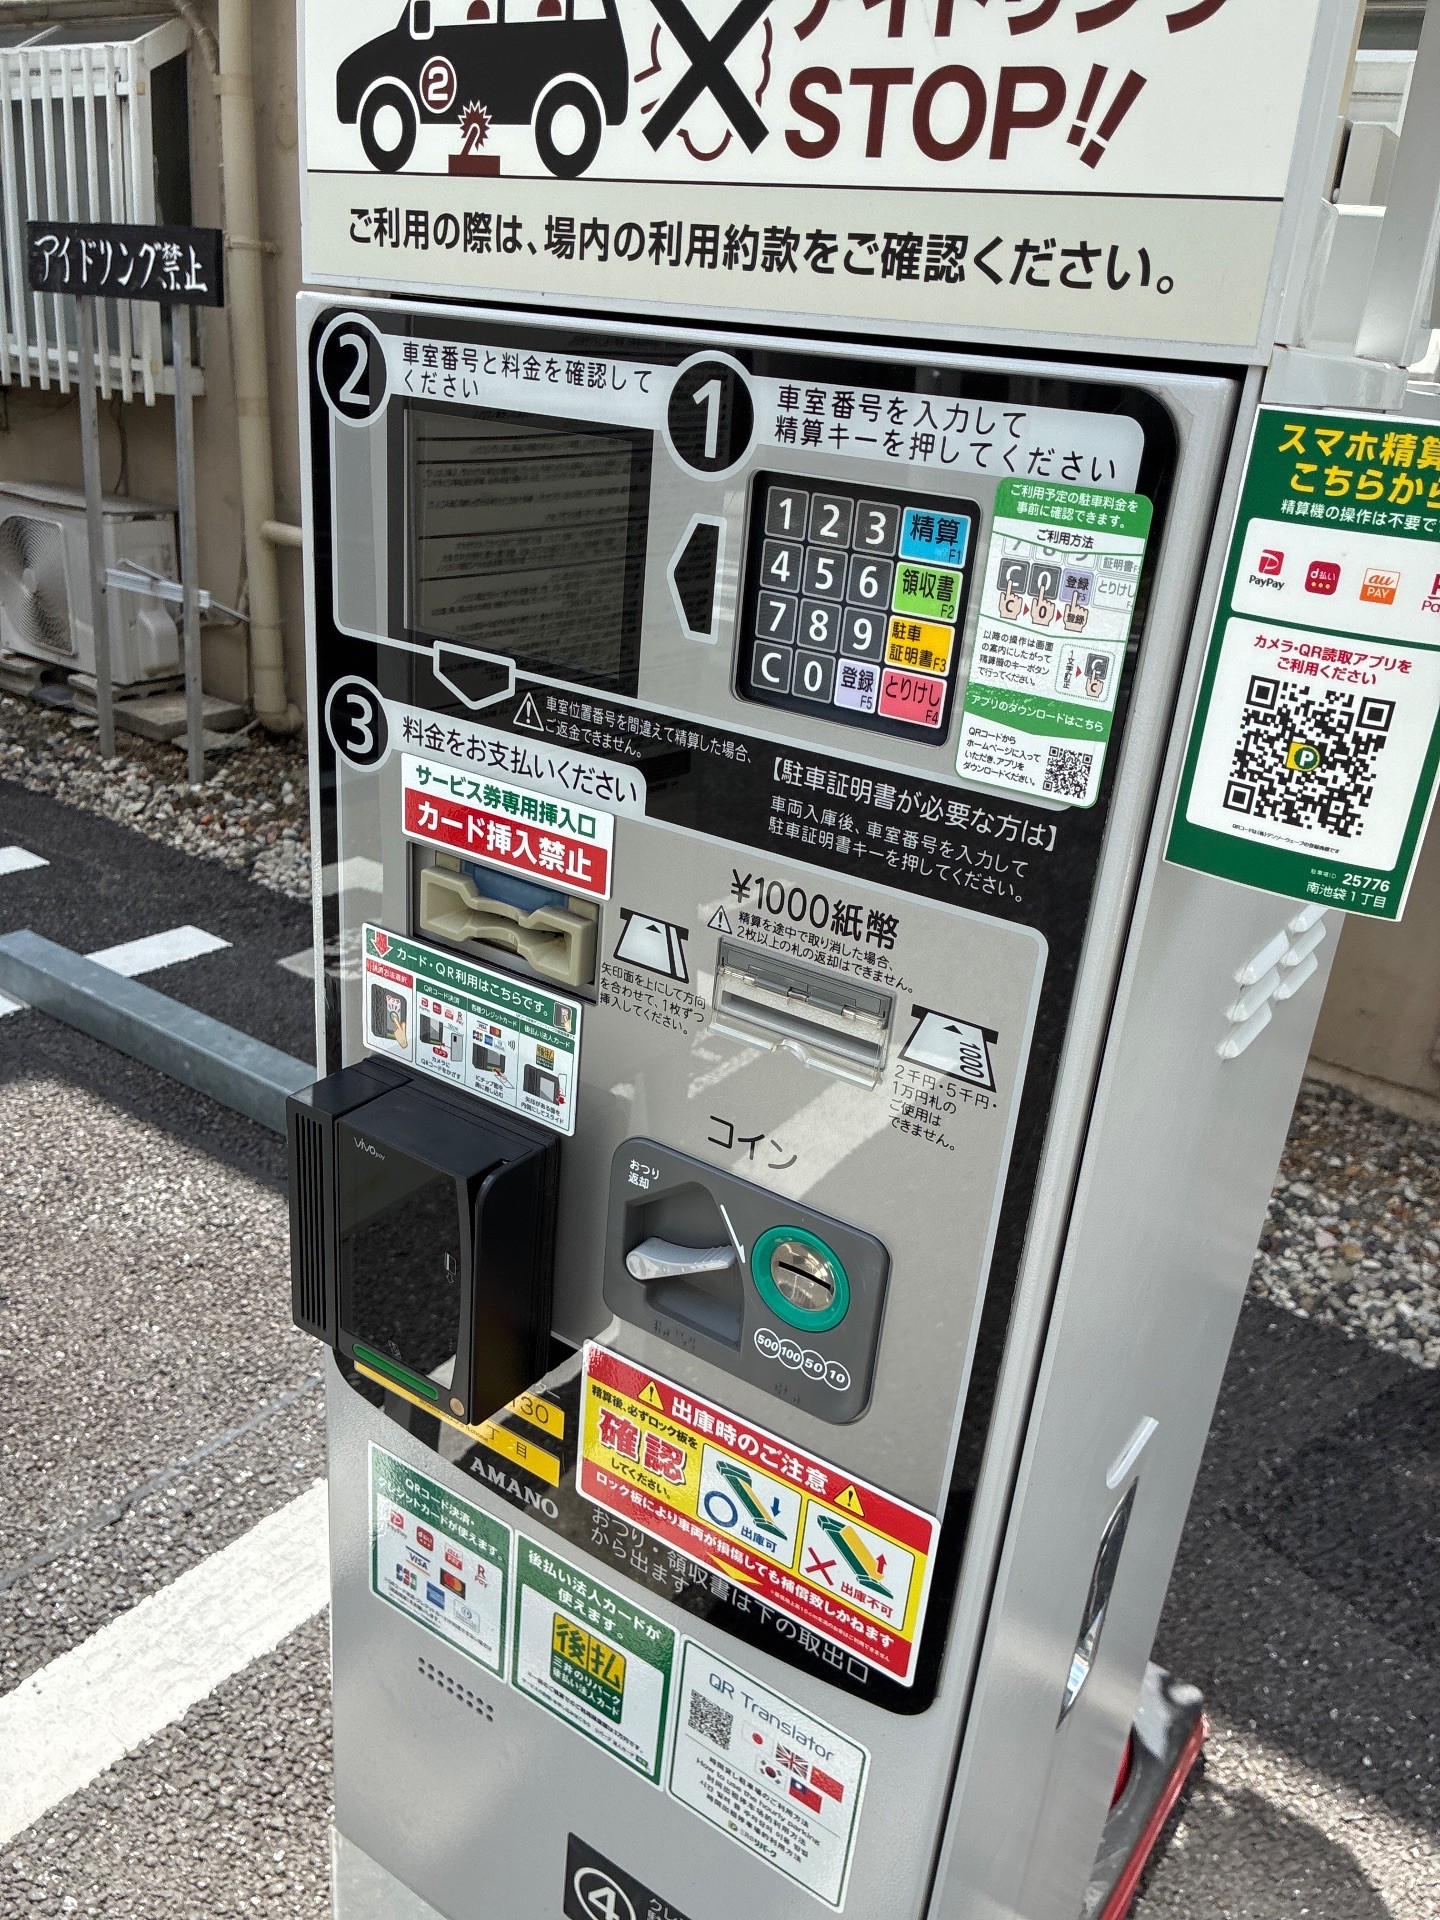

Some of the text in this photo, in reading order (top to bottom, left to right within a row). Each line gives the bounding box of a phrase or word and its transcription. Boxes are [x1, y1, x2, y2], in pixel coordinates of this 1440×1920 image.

[784, 62, 1148, 170] STOP!!
[34, 235, 209, 293] アイドリング禁止
[349, 207, 1174, 296] ご利用の際は、場内の利用約款をご確認ください。
[339, 333, 370, 406] 2
[402, 341, 653, 394] 車室番号と料金を確認して
[403, 369, 480, 399] ください
[692, 379, 723, 459] 1
[777, 384, 1029, 439] 車室番号を入力して
[774, 415, 1117, 482] 精算キーを押してください
[779, 497, 793, 530] 1
[1010, 483, 1139, 513] ご利用予定の駐車料金を
[1016, 501, 1125, 529] 事前に確認できます。
[819, 504, 840, 538] 2
[865, 511, 887, 546] 3
[909, 513, 961, 547] 精算
[1280, 499, 1440, 533] 精算機の操作は不要で
[1036, 528, 1095, 550] ご利用方法
[770, 550, 791, 583] 4
[814, 557, 834, 590] 5
[949, 549, 962, 565] F1
[1310, 567, 1336, 582] d払い
[858, 565, 878, 599] 6
[902, 568, 955, 603] 領収書
[1065, 575, 1090, 591] 登録
[1097, 580, 1135, 598] とりけし
[1248, 574, 1285, 591] PayPay
[1366, 586, 1391, 600] PAY
[1368, 573, 1394, 587] au
[769, 601, 787, 632] 7
[940, 604, 955, 619] F2
[1005, 599, 1014, 613] C
[1038, 605, 1047, 619] 0
[1066, 612, 1085, 625] 登録
[809, 609, 828, 642] 8
[852, 617, 872, 650] 9
[892, 621, 921, 642] 駐車
[983, 629, 1054, 652] 以降の操作は画面
[761, 652, 782, 683] C
[889, 643, 932, 668] 証明書
[933, 657, 947, 673] F3
[979, 654, 1050, 676] 精算機のキーボタン
[981, 643, 1052, 664] の案内にしたがって
[1253, 635, 1413, 674] カメラ・QR読取アプリを
[1277, 656, 1377, 685] ご利用ください
[803, 660, 823, 692] 0
[841, 666, 874, 693] 登録
[885, 675, 941, 707] とりけし
[977, 667, 1036, 687] で行ってください。
[860, 695, 873, 710] F5
[925, 710, 939, 725] F4
[972, 694, 1104, 732] アプリのダウンロードはこちら
[346, 694, 374, 754] 3
[544, 717, 643, 760] ご返金できません。
[545, 695, 752, 764] 車室位置番号を間違えて精算した場合、
[968, 726, 1017, 745] QRコードから
[402, 715, 637, 803] 料金をお支払いください
[964, 750, 1025, 771] いただき、アプリを
[966, 739, 1042, 763] ホームページに入って
[963, 761, 1036, 786] ダウンロードください。
[416, 765, 597, 839] サービス券専用挿入口
[772, 756, 1058, 852] 【駐車証明書が必要な方は】
[417, 801, 593, 882] カード挿入禁止
[771, 795, 1029, 879] 車両入庫後、車室番号を入力して
[768, 816, 1023, 903] 駐車証明書キーを押してください。
[1342, 873, 1391, 893] 25776
[730, 868, 900, 950] ¥1000紙幣
[738, 911, 894, 972] 精算を途中で取り消した場合、
[736, 925, 914, 994] 2枚以上の札の返却はできません。
[397, 947, 549, 1018] カード・QR利用はこちらです。
[600, 977, 705, 1023] を合わせて、1枚ずつ
[601, 962, 706, 1010] 矢印面を上にして方向
[600, 992, 688, 1035] 挿入してください。
[958, 1041, 985, 1079] 1000
[889, 1098, 942, 1127] ご使用は
[892, 1080, 957, 1115] 1万円札の
[707, 1115, 798, 1170] コイン
[889, 1115, 955, 1151] できません。
[627, 1171, 650, 1190] 返却
[629, 1158, 660, 1181] おつり
[757, 1334, 845, 1384] 500 100 50 10
[591, 1384, 699, 1450] 精算後、必ずロック板を
[599, 1407, 687, 1485] 確認
[671, 1396, 828, 1496] 出庫時のご注意
[470, 1457, 559, 1519] AMANO
[611, 1457, 671, 1500] してください。
[378, 1476, 503, 1561] クレジットカードが使えます。
[741, 1525, 778, 1554] 出庫可
[409, 1552, 428, 1571] VISA
[591, 1527, 690, 1594] から出ます
[596, 1471, 895, 1648] ロック板により車両が損傷しても補償致しかねます
[528, 1549, 662, 1641] 後払い法人カードが
[592, 1507, 868, 1683] おつり・領収書は下の取出口
[840, 1581, 894, 1619] 出庫不可
[557, 1589, 624, 1640] 使えます。
[555, 1622, 621, 1687] 後払
[552, 1668, 621, 1717] 後払い法人カード
[553, 1657, 621, 1706] 三井のリパーク
[708, 1672, 835, 1762] QR Translator
[743, 1789, 758, 1803] the
[759, 1800, 786, 1822] hourly
[787, 1820, 821, 1847] parking
